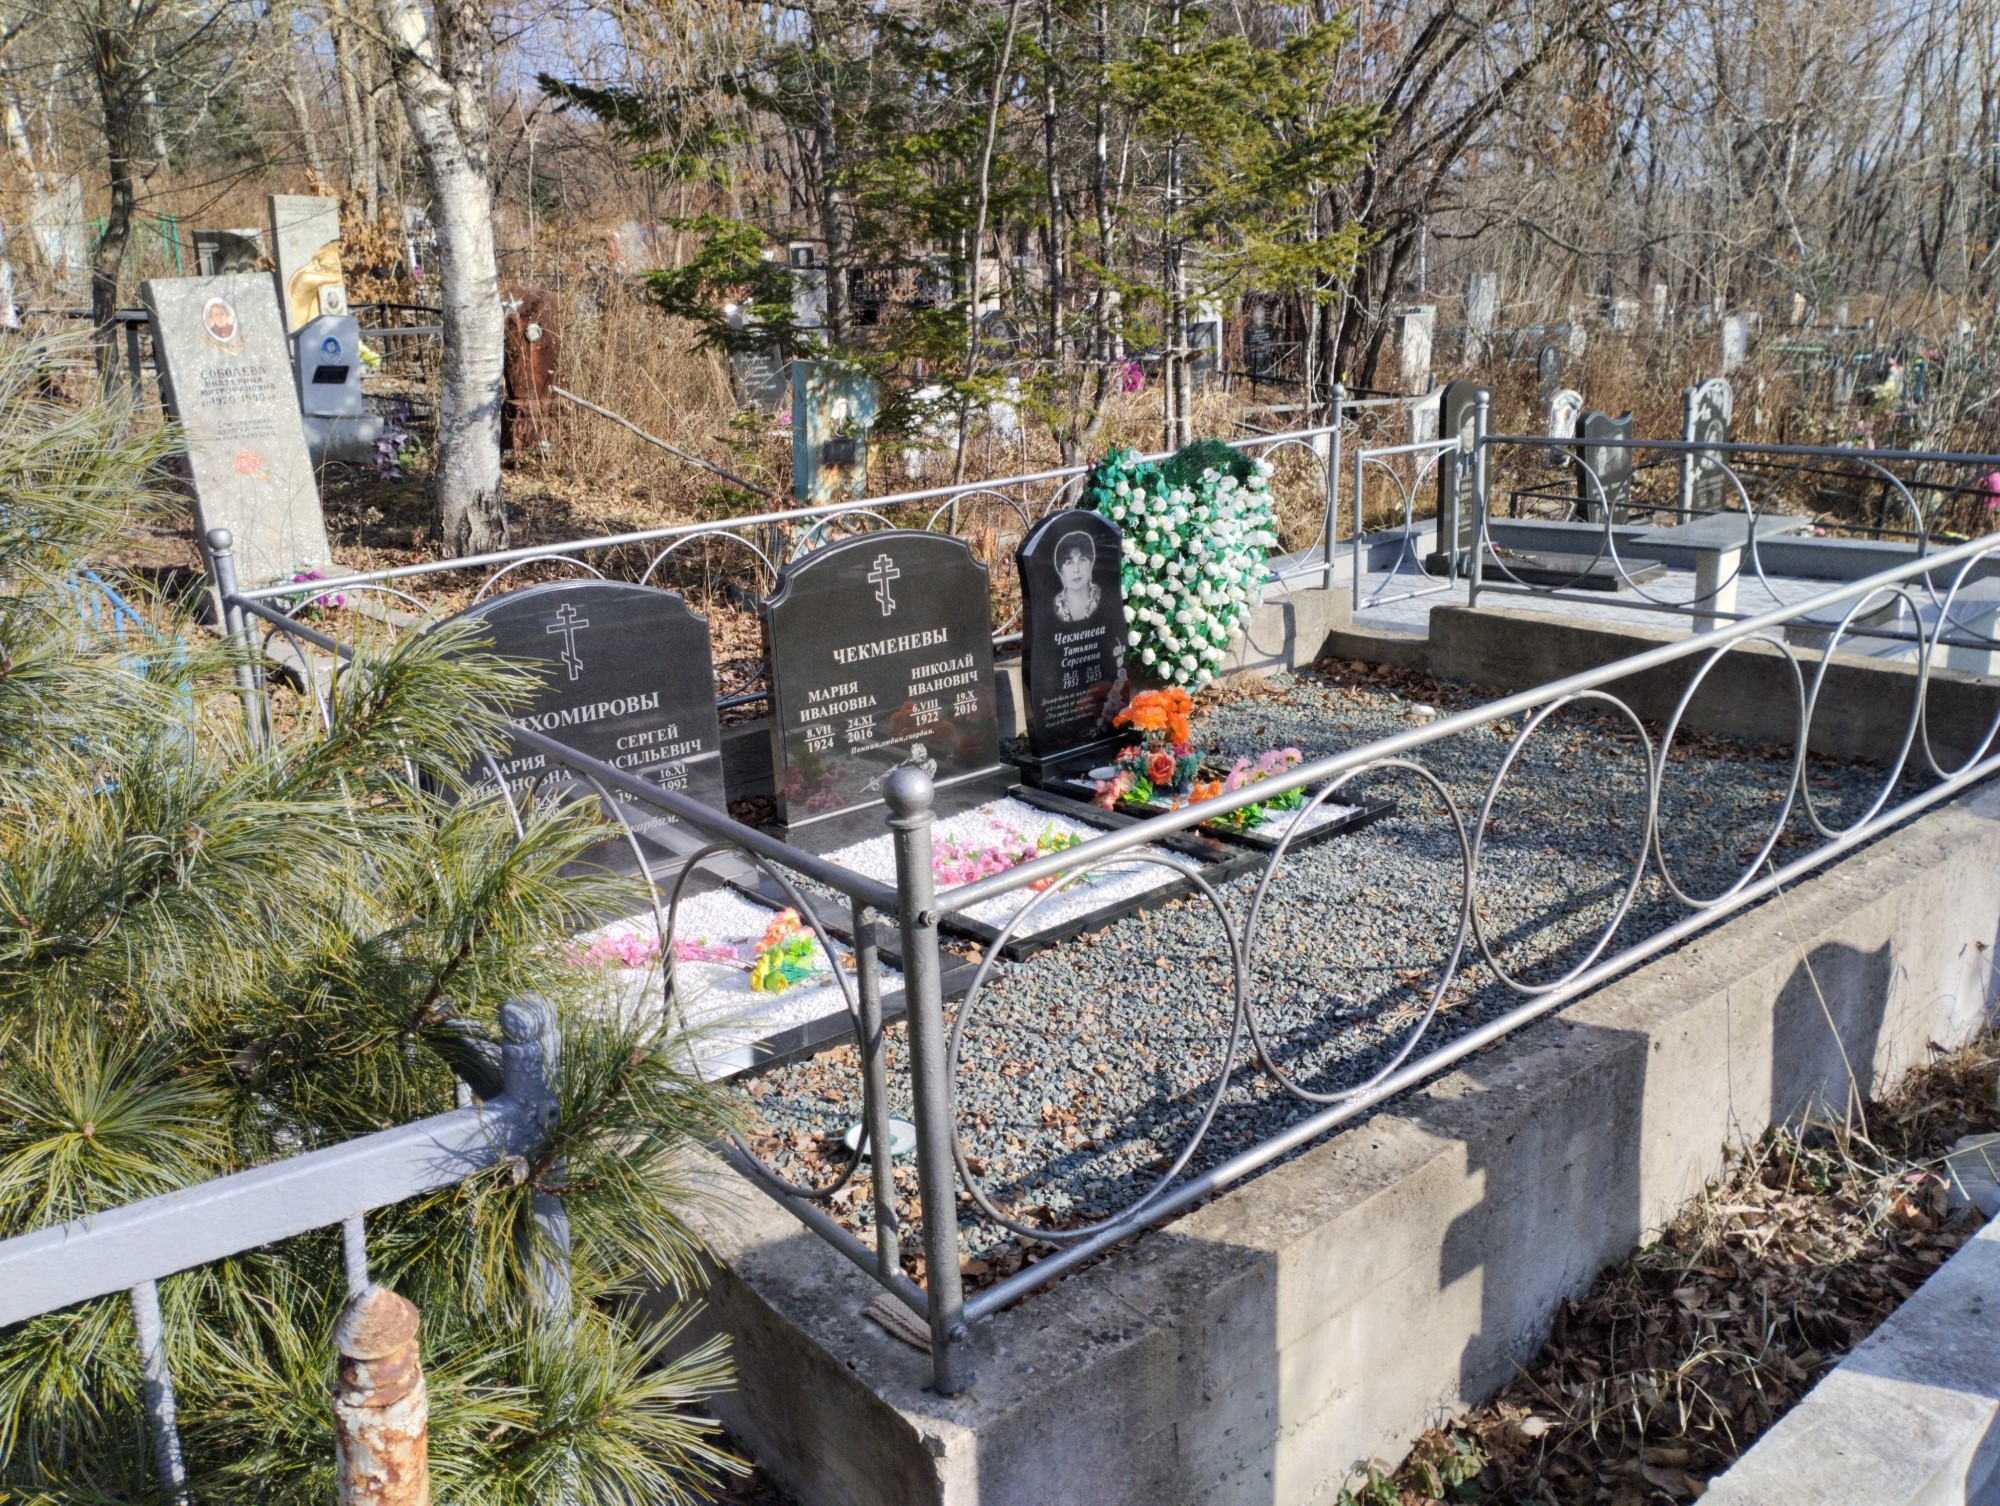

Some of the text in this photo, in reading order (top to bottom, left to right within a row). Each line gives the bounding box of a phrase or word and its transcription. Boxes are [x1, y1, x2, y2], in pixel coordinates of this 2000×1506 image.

[200, 366, 267, 380] СОБОЛЕВА
[1054, 625, 1106, 646] Чекменева
[832, 627, 949, 665] ЧЕКМЕНЕВЫ
[1063, 641, 1099, 657] Татьяна
[911, 653, 975, 680] НИКОЛАЙ
[1061, 652, 1101, 669] Сергеевна
[908, 670, 979, 697] ИВАНОВИЧ
[1063, 671, 1102, 690] 1951 2023
[807, 681, 859, 704] МАРИЯ
[955, 690, 975, 703] 19.X
[502, 691, 661, 739] ИХОМИРОВЫ
[799, 694, 878, 723] ИВАНОВНА
[912, 699, 940, 714] 6.VIII
[954, 701, 978, 717] 2016
[847, 714, 874, 729] 24.XI
[915, 711, 940, 727] 1922
[616, 723, 680, 750] СЕРГЕЙ
[805, 724, 833, 740] 8.VII
[847, 727, 873, 744] 2016
[602, 738, 702, 770] АСИЛЬЕВИЧ
[807, 737, 834, 753] 1924
[482, 754, 547, 780] МАРИЯ
[661, 776, 689, 793] 1992
[628, 814, 679, 834] корбим.
